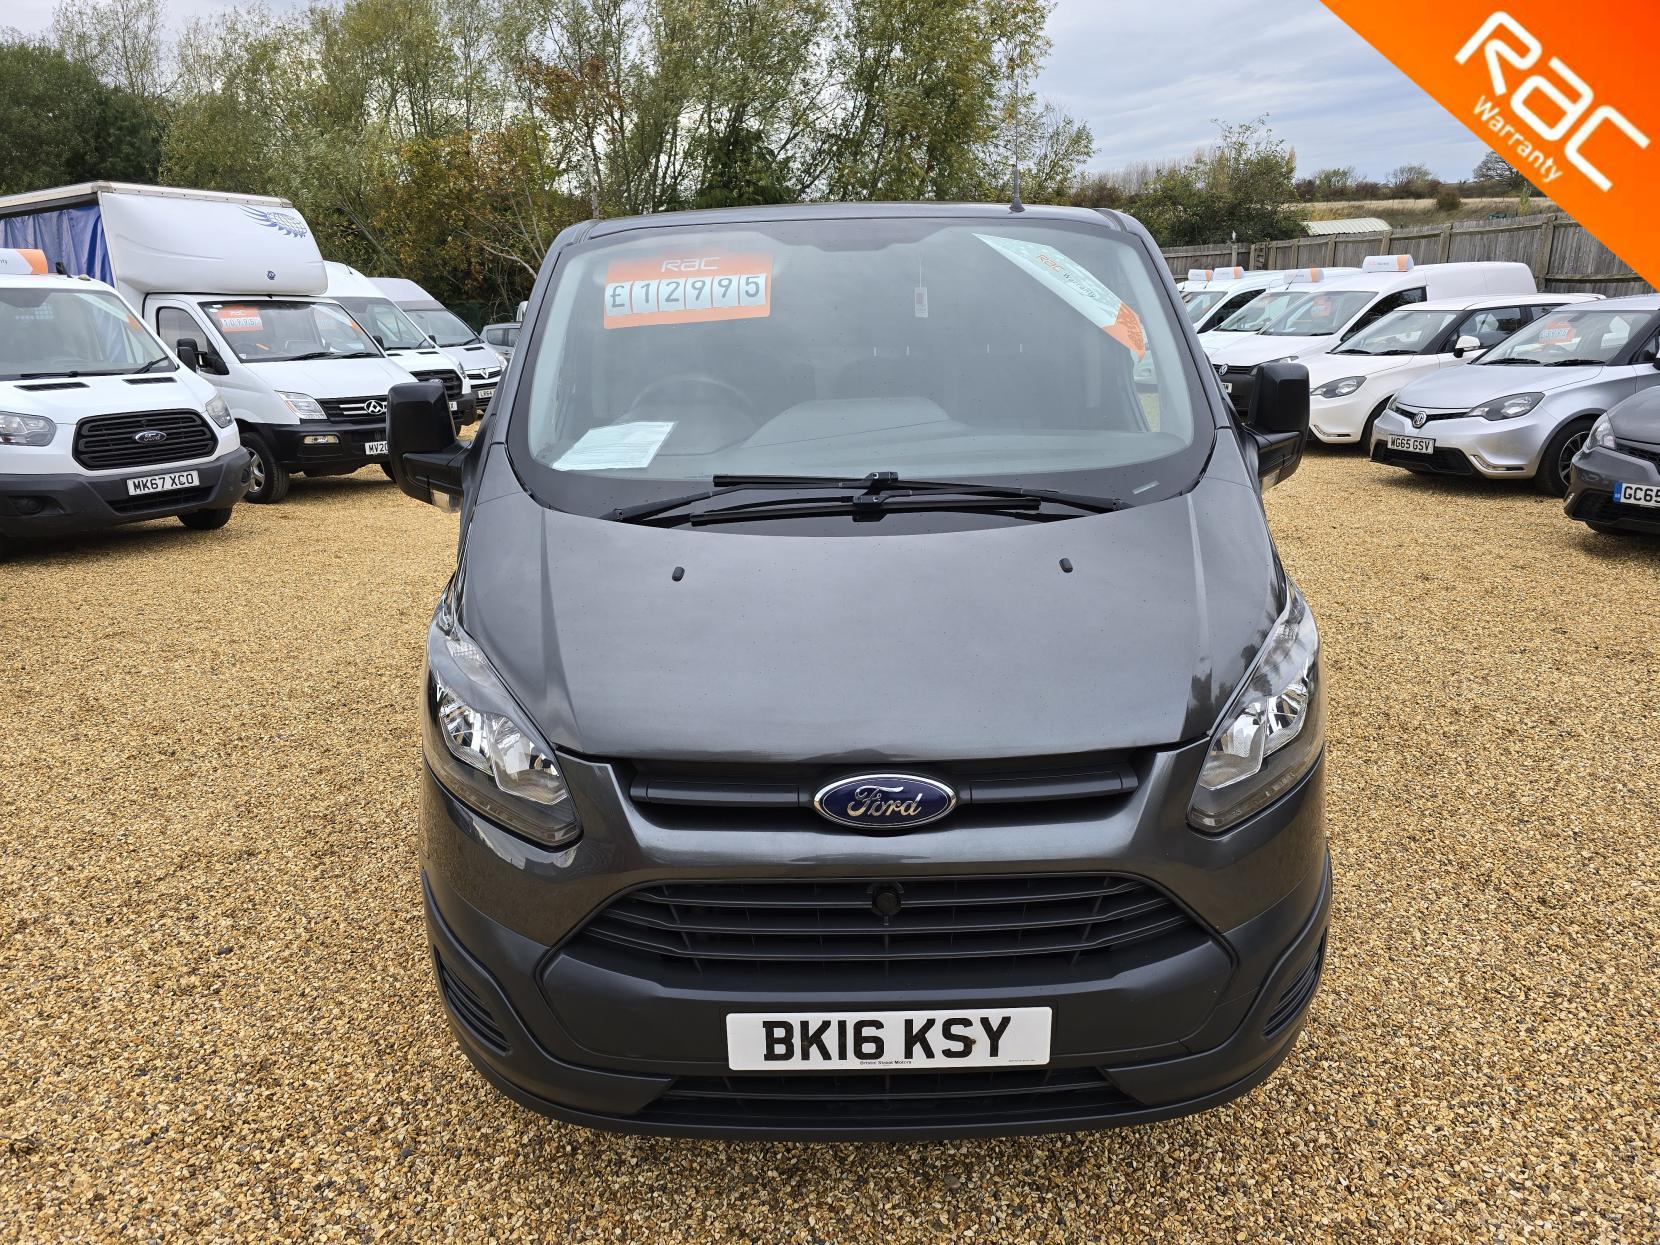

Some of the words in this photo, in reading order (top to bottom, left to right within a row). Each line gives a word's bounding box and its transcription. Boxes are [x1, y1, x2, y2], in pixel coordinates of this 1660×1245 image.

[609, 275, 761, 308] £12995
[1390, 436, 1411, 449] WG65
[1412, 439, 1430, 451] GSV
[132, 476, 166, 493] MK67
[169, 473, 194, 487] XCO
[1623, 486, 1660, 503] GC65
[847, 785, 923, 817] Ford
[762, 1019, 885, 1061] BK16
[904, 1016, 1012, 1060] KSY
